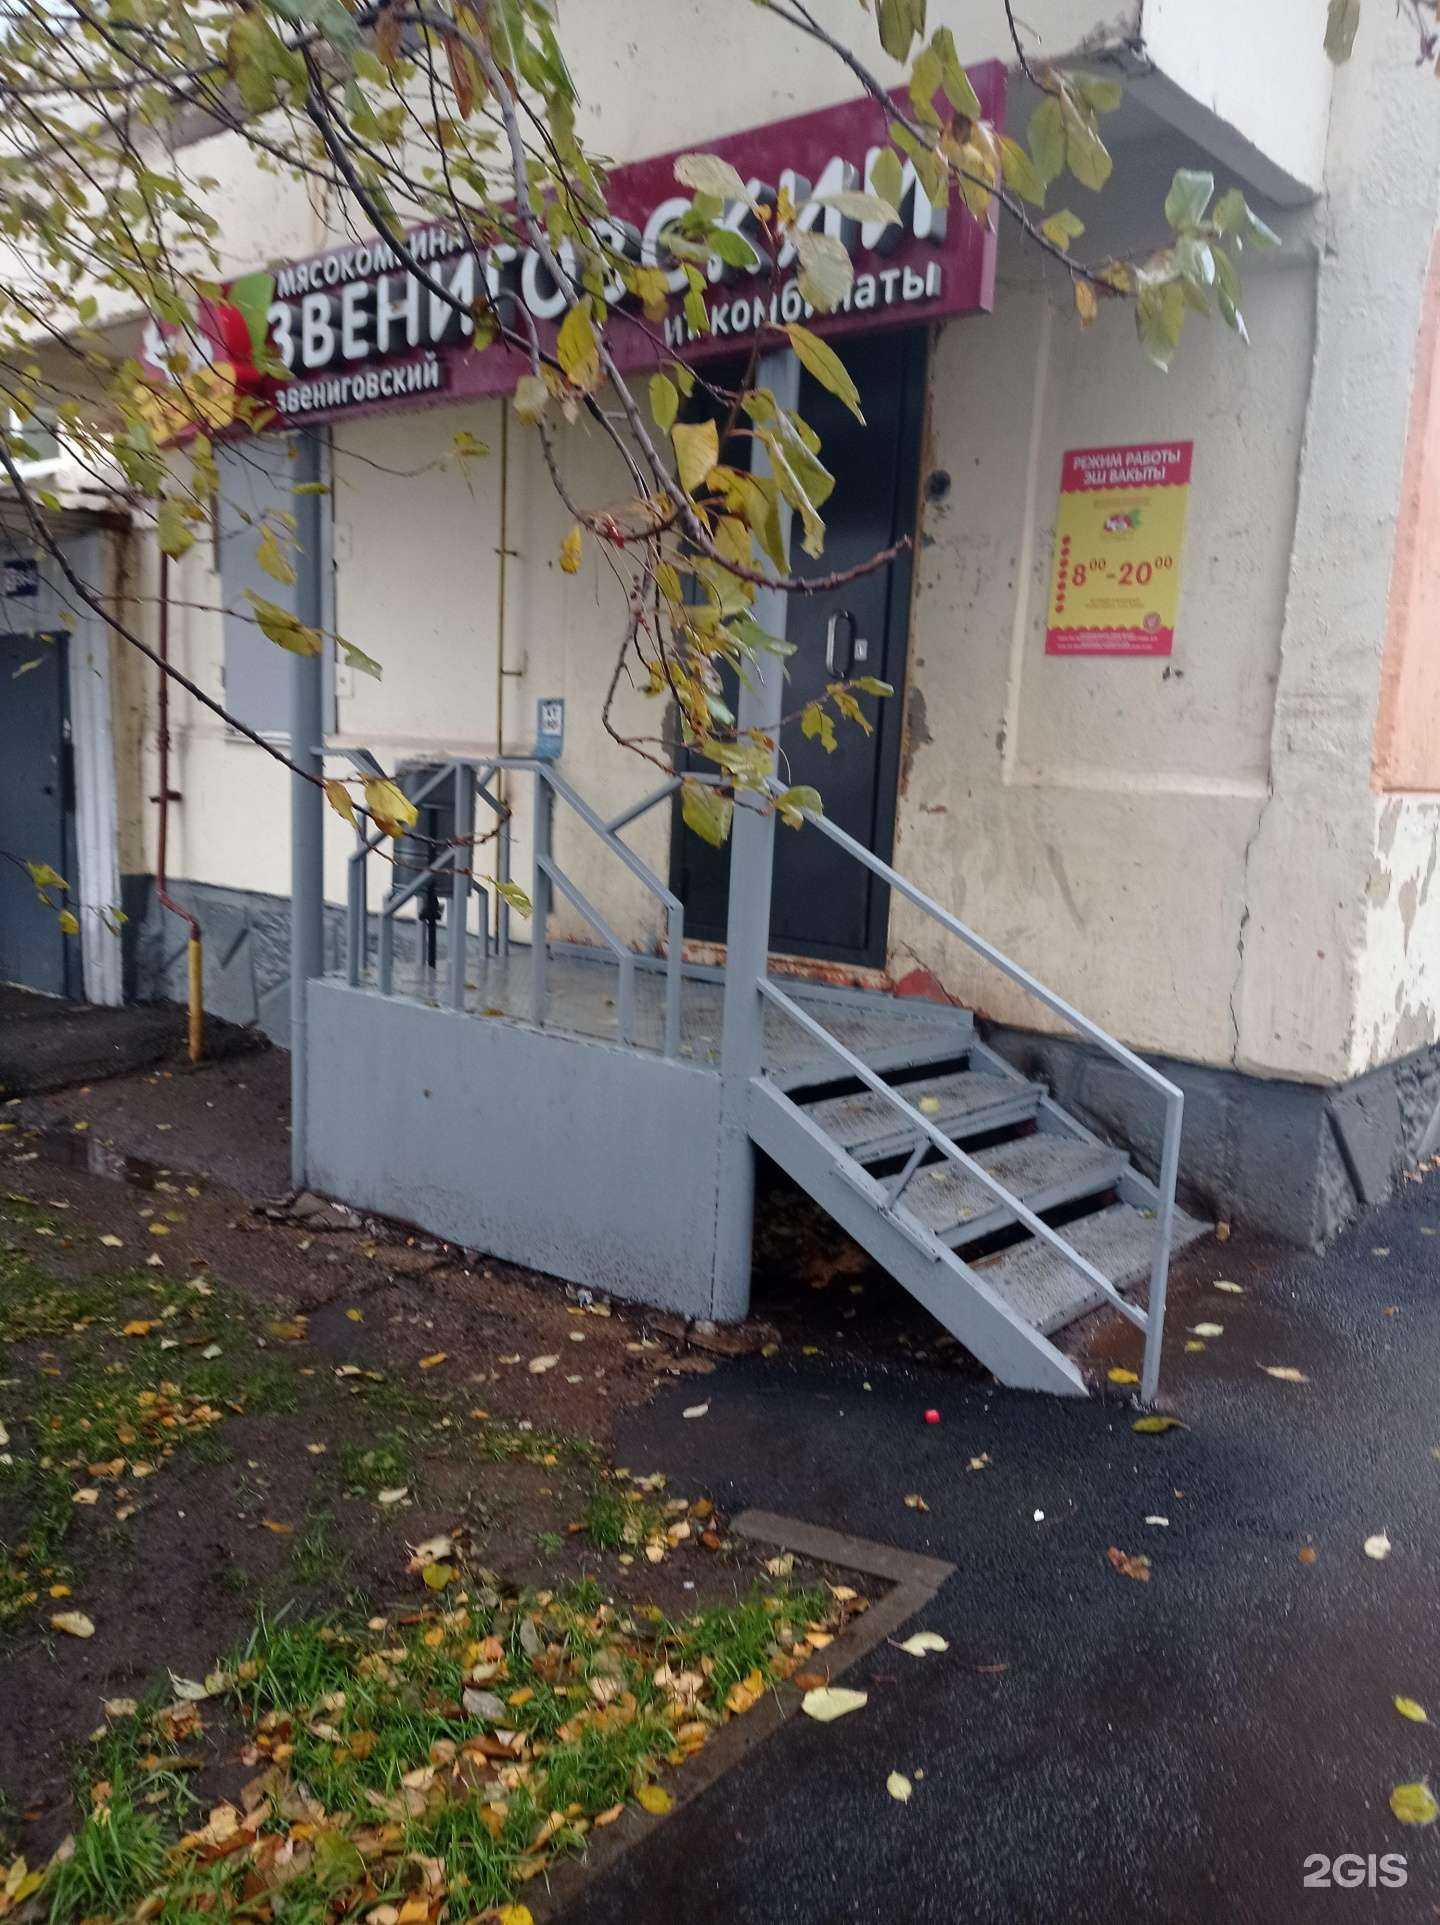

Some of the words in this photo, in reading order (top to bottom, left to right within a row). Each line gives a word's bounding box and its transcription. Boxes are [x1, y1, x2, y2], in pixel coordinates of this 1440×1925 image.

[710, 260, 940, 337] комбаты
[1073, 452, 1122, 471] РЕЖИМ
[1125, 449, 1181, 467] РАБОТЫ
[1083, 469, 1106, 485] ЭШ
